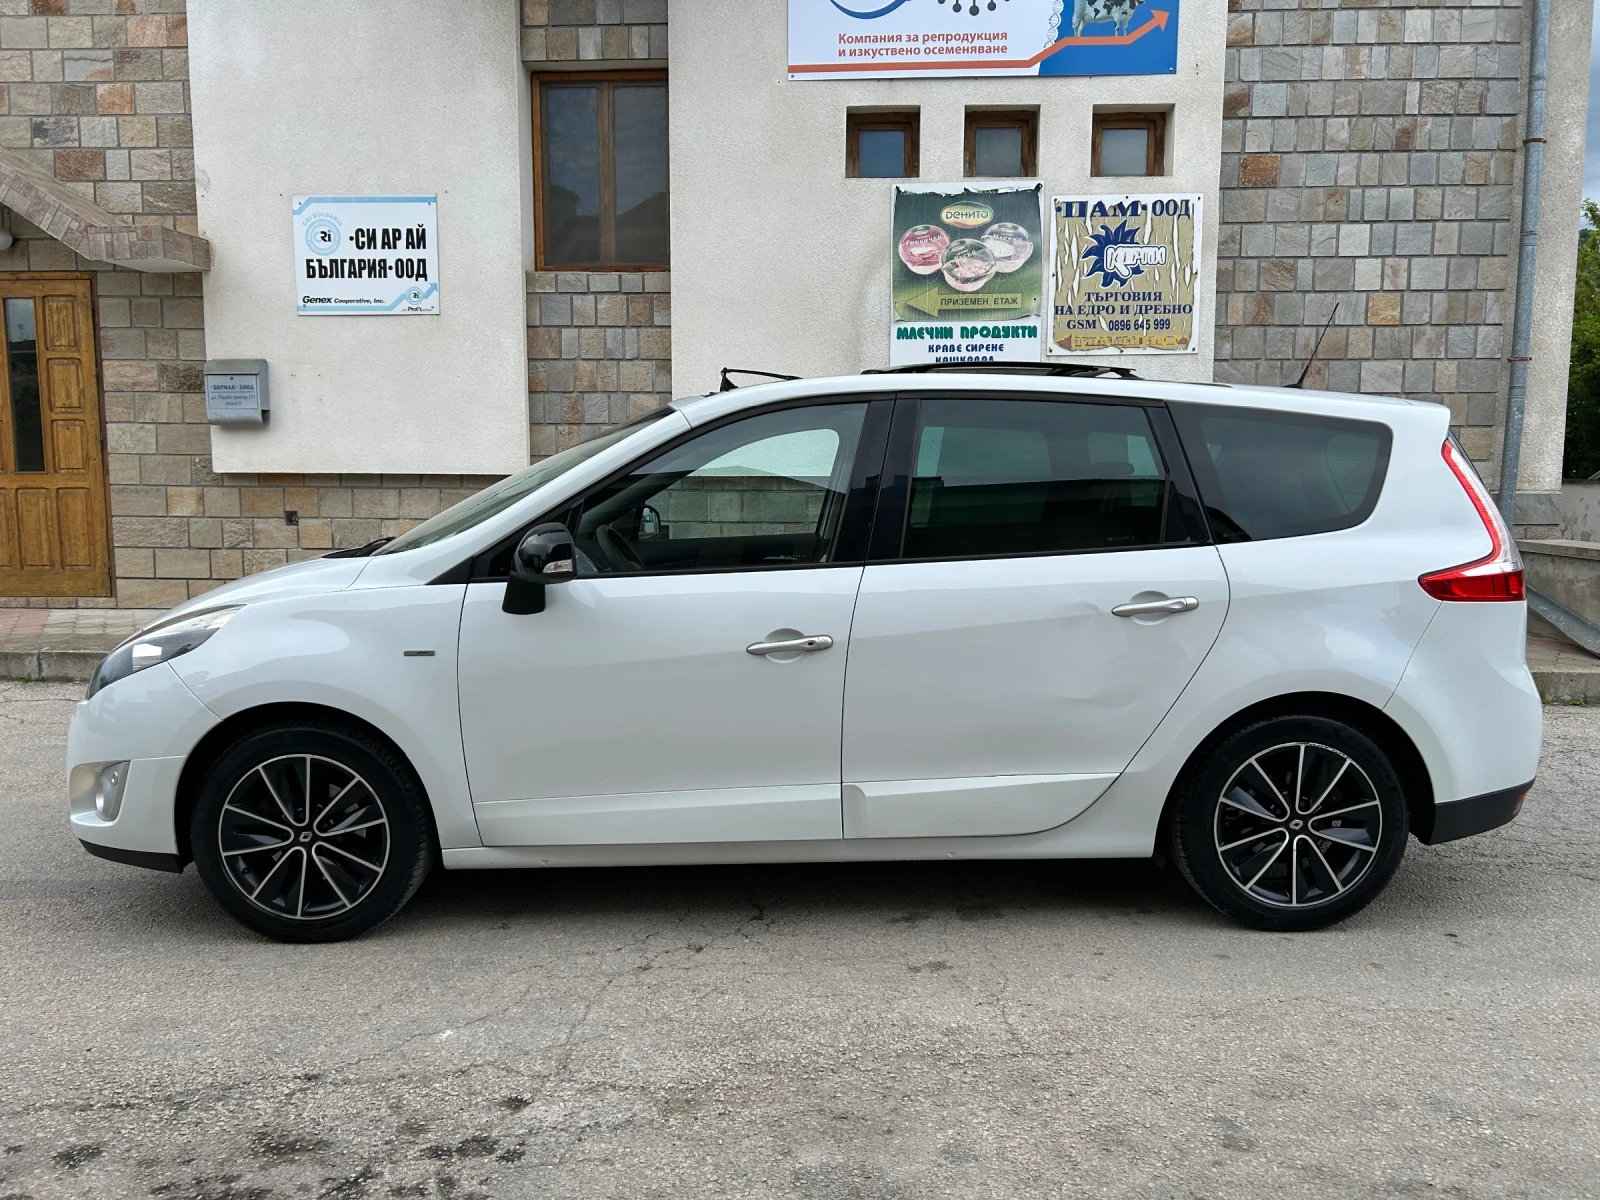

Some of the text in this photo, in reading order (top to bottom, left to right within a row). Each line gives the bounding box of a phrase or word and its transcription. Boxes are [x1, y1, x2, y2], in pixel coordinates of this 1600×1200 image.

[838, 34, 902, 44] Компания
[922, 32, 1008, 44] репродукция
[849, 47, 920, 58] изкуствено
[924, 45, 1008, 55] осеменяване
[1152, 199, 1190, 220] ООД
[312, 212, 343, 227] BULGARIA
[381, 228, 401, 249] АР
[406, 224, 426, 249] АЙ
[302, 296, 332, 304] Genex
[1084, 291, 1162, 302] ТЪРГОВИЯ
[1054, 304, 1192, 316] НА ЕДРО И ДРЕБНО
[1067, 319, 1170, 331] GSM 0896 645 999
[896, 325, 1038, 340] МЛЕЧНИ ПРОДУКТИ
[928, 344, 1004, 352] КРАВЕ СИРЕНЕ
